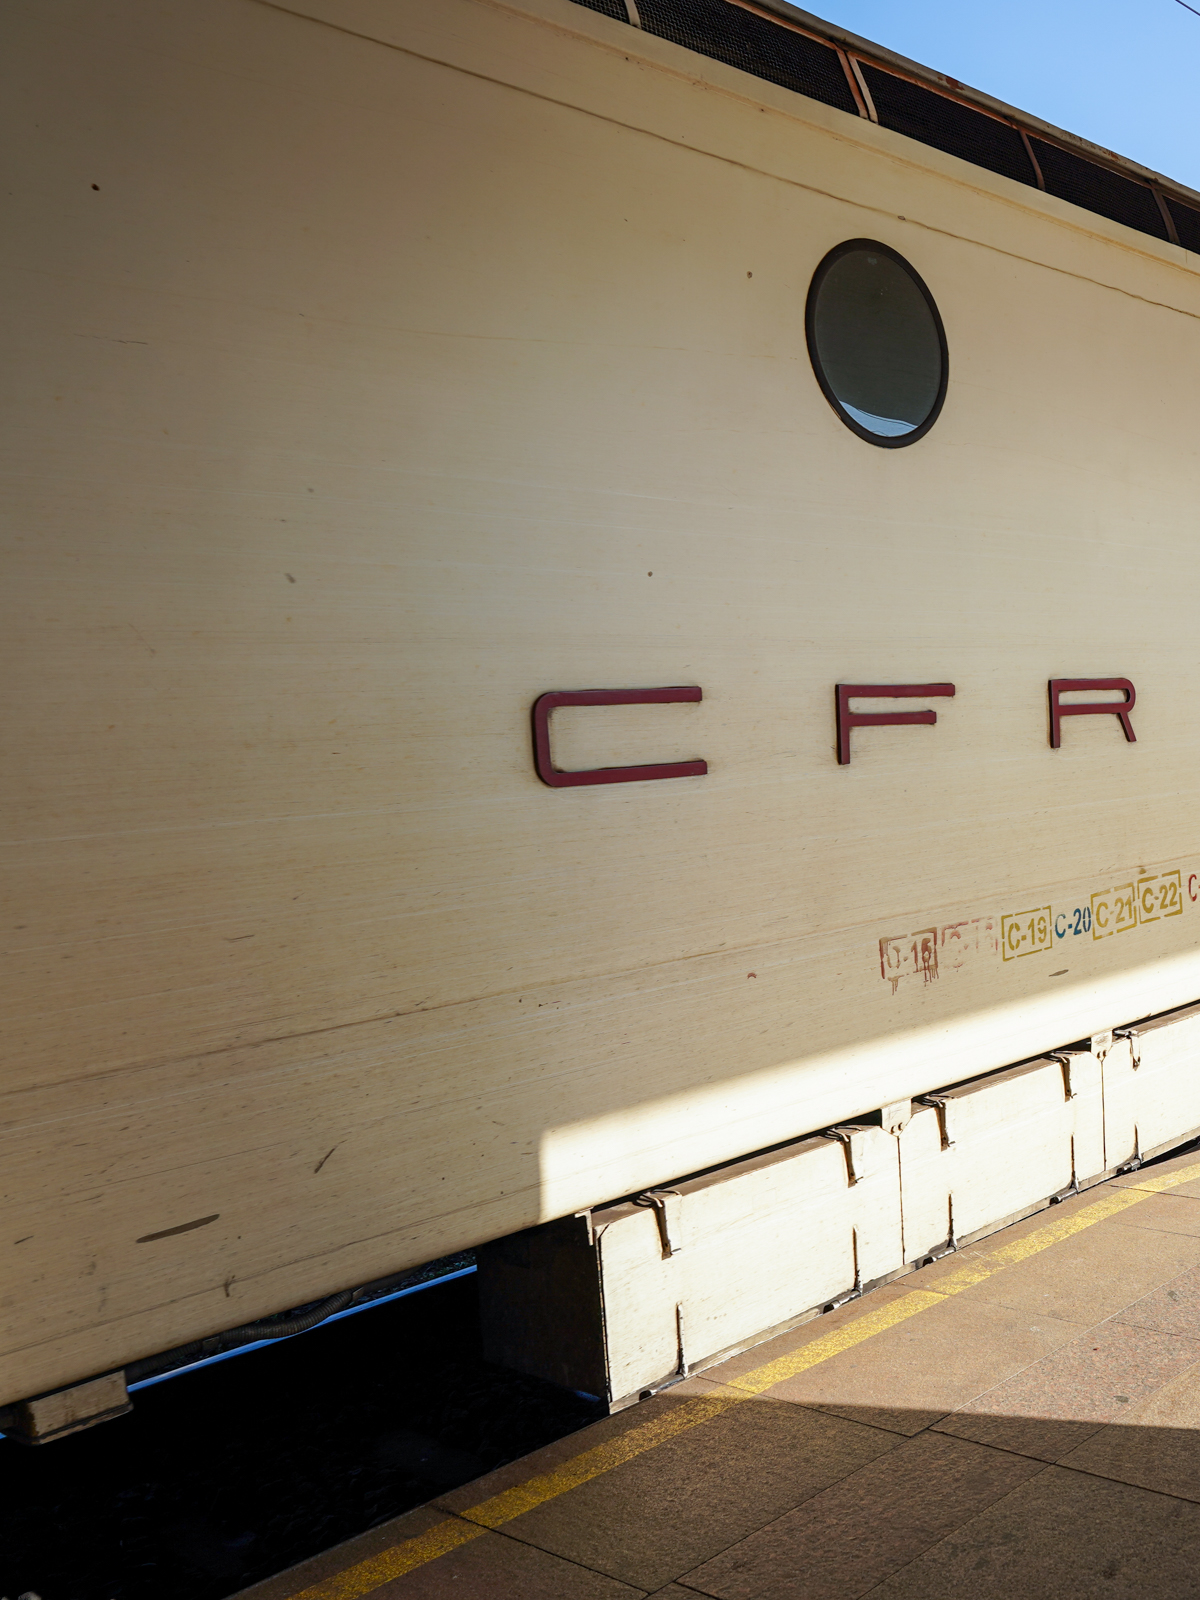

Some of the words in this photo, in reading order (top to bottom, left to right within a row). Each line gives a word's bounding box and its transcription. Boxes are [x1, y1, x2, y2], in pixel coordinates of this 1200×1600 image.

[1008, 916, 1047, 951] C-19
[1055, 906, 1092, 939] C-20
[1096, 895, 1133, 928] C-21
[1142, 881, 1178, 914] C-22
